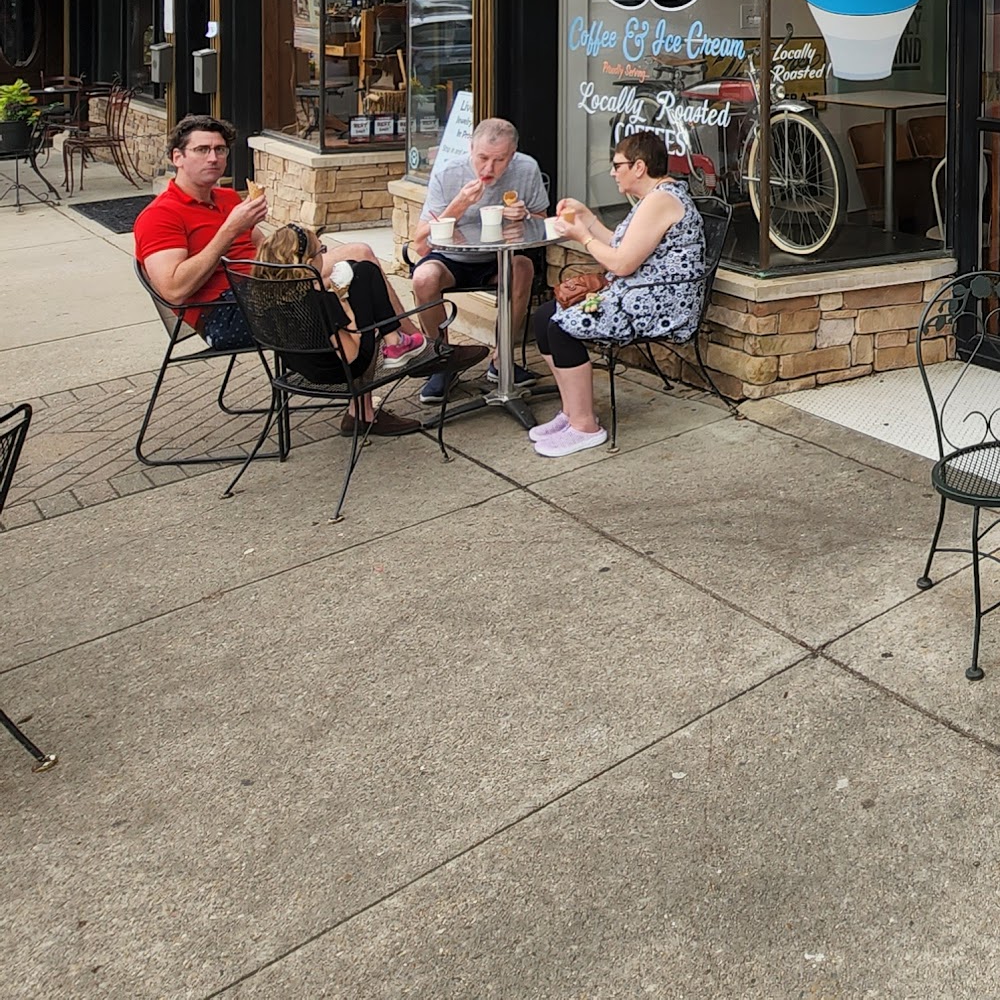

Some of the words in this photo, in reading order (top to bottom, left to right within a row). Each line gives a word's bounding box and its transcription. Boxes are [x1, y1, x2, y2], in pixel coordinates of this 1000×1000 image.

[569, 16, 618, 57] Coffee
[622, 17, 649, 61] &
[652, 19, 682, 58] Ice
[687, 20, 746, 59] Cream
[773, 43, 816, 63] Locally
[603, 61, 624, 79] Proudly
[578, 81, 646, 124] Locally
[656, 91, 731, 127] Roasted
